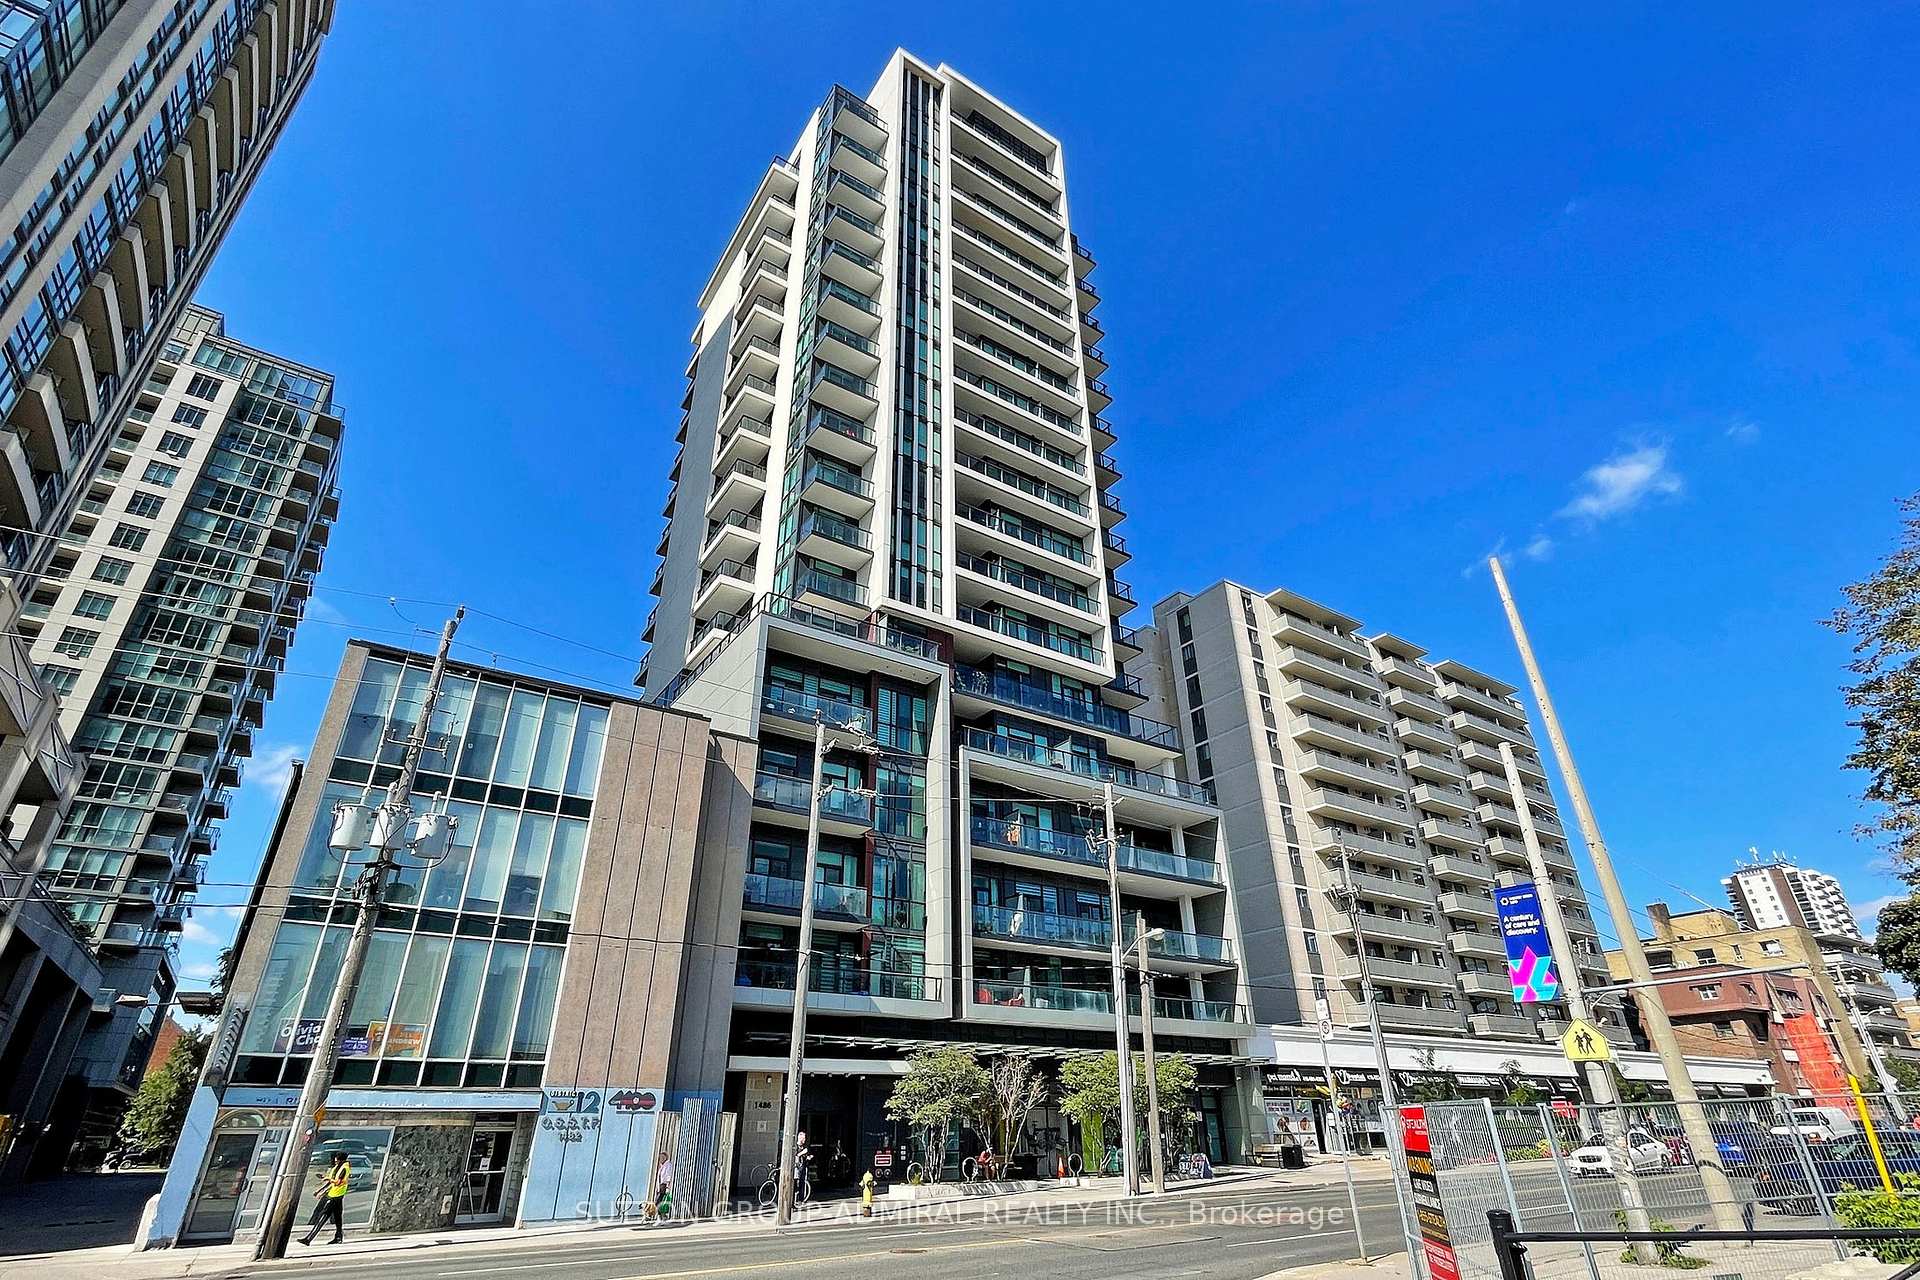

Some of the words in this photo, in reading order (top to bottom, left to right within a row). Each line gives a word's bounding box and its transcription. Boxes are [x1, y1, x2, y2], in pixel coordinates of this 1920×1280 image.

[280, 1023, 321, 1038] Oivia
[577, 1091, 600, 1113] 12
[754, 1101, 771, 1109] 1486
